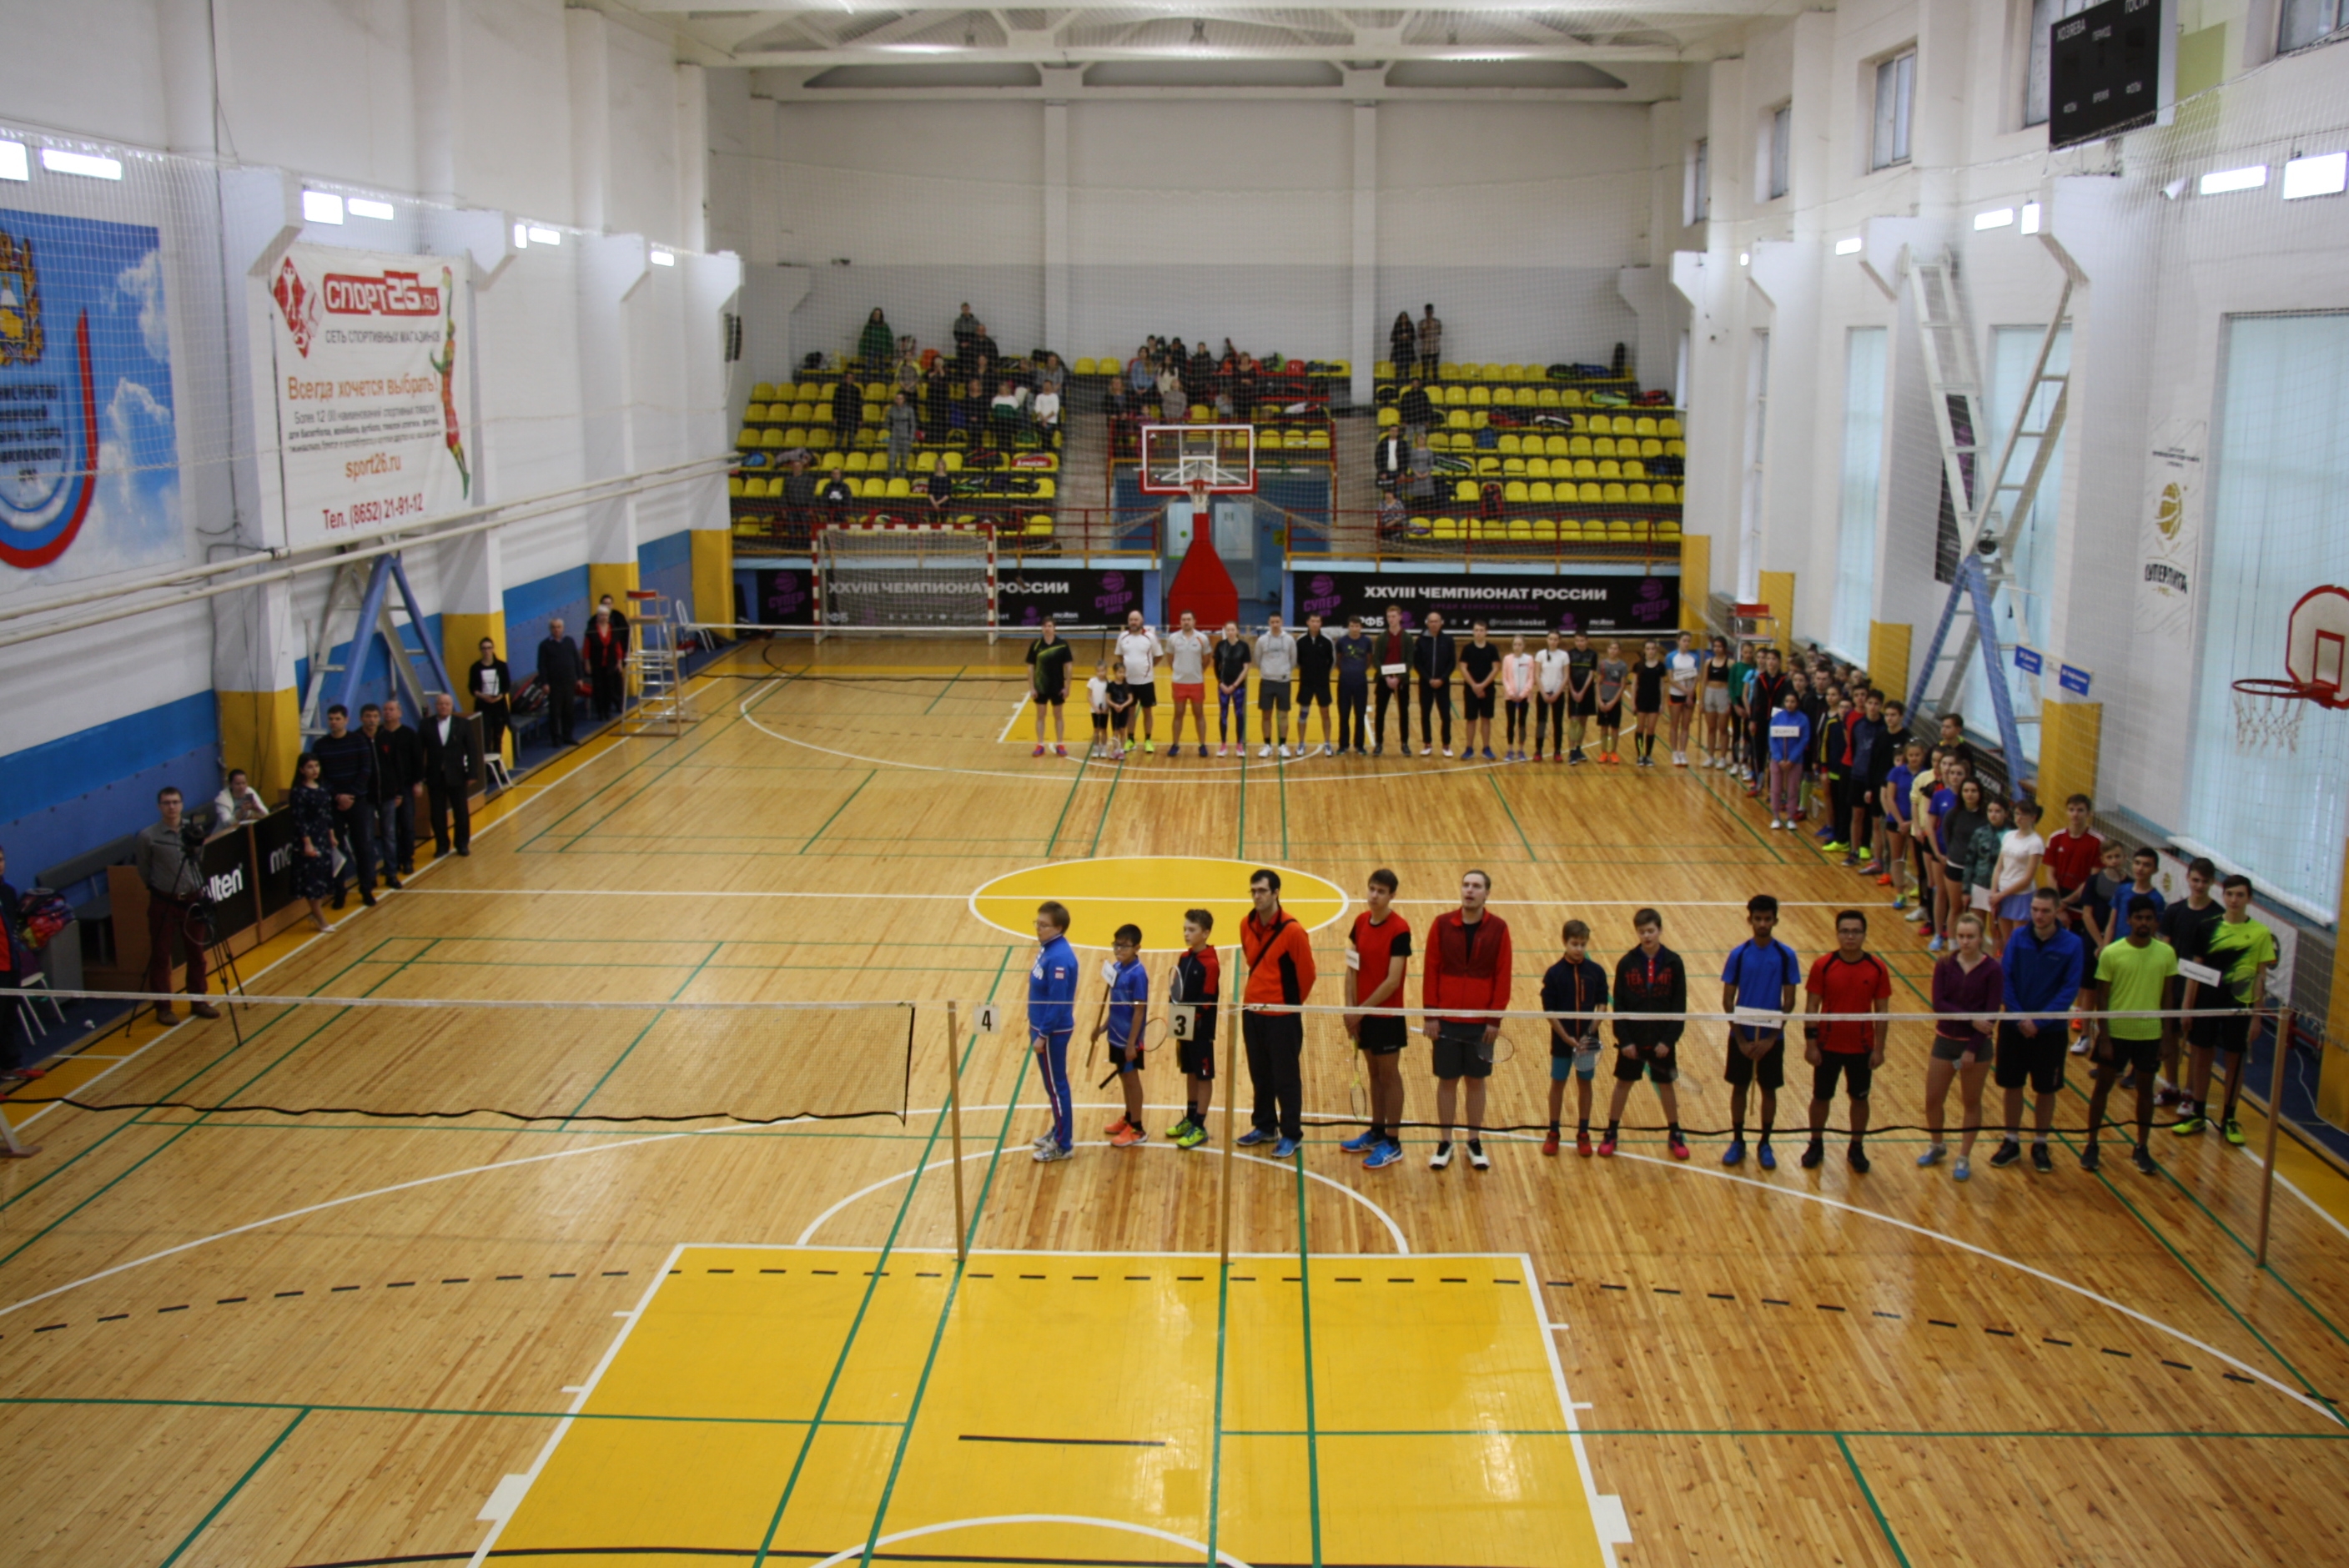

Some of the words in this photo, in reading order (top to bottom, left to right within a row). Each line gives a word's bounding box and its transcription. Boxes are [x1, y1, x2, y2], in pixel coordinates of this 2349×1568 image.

[2057, 18, 2085, 42] ХОЗЯЕВА
[325, 329, 347, 344] СЕТЬ
[288, 376, 334, 401] Всегда
[338, 379, 384, 398] хочется
[387, 373, 438, 398] выбрать!
[345, 452, 401, 482] sport26.ru
[323, 509, 346, 530] Тел.
[350, 500, 382, 530] (8652)
[385, 493, 423, 519] 21-91-12
[997, 582, 1069, 594] РОССИИ
[1419, 587, 1529, 600] ЧЕМПИОНАТ
[1532, 588, 1607, 601] РОССИИ
[982, 1010, 992, 1031] 4
[1174, 1015, 1186, 1036] 3
